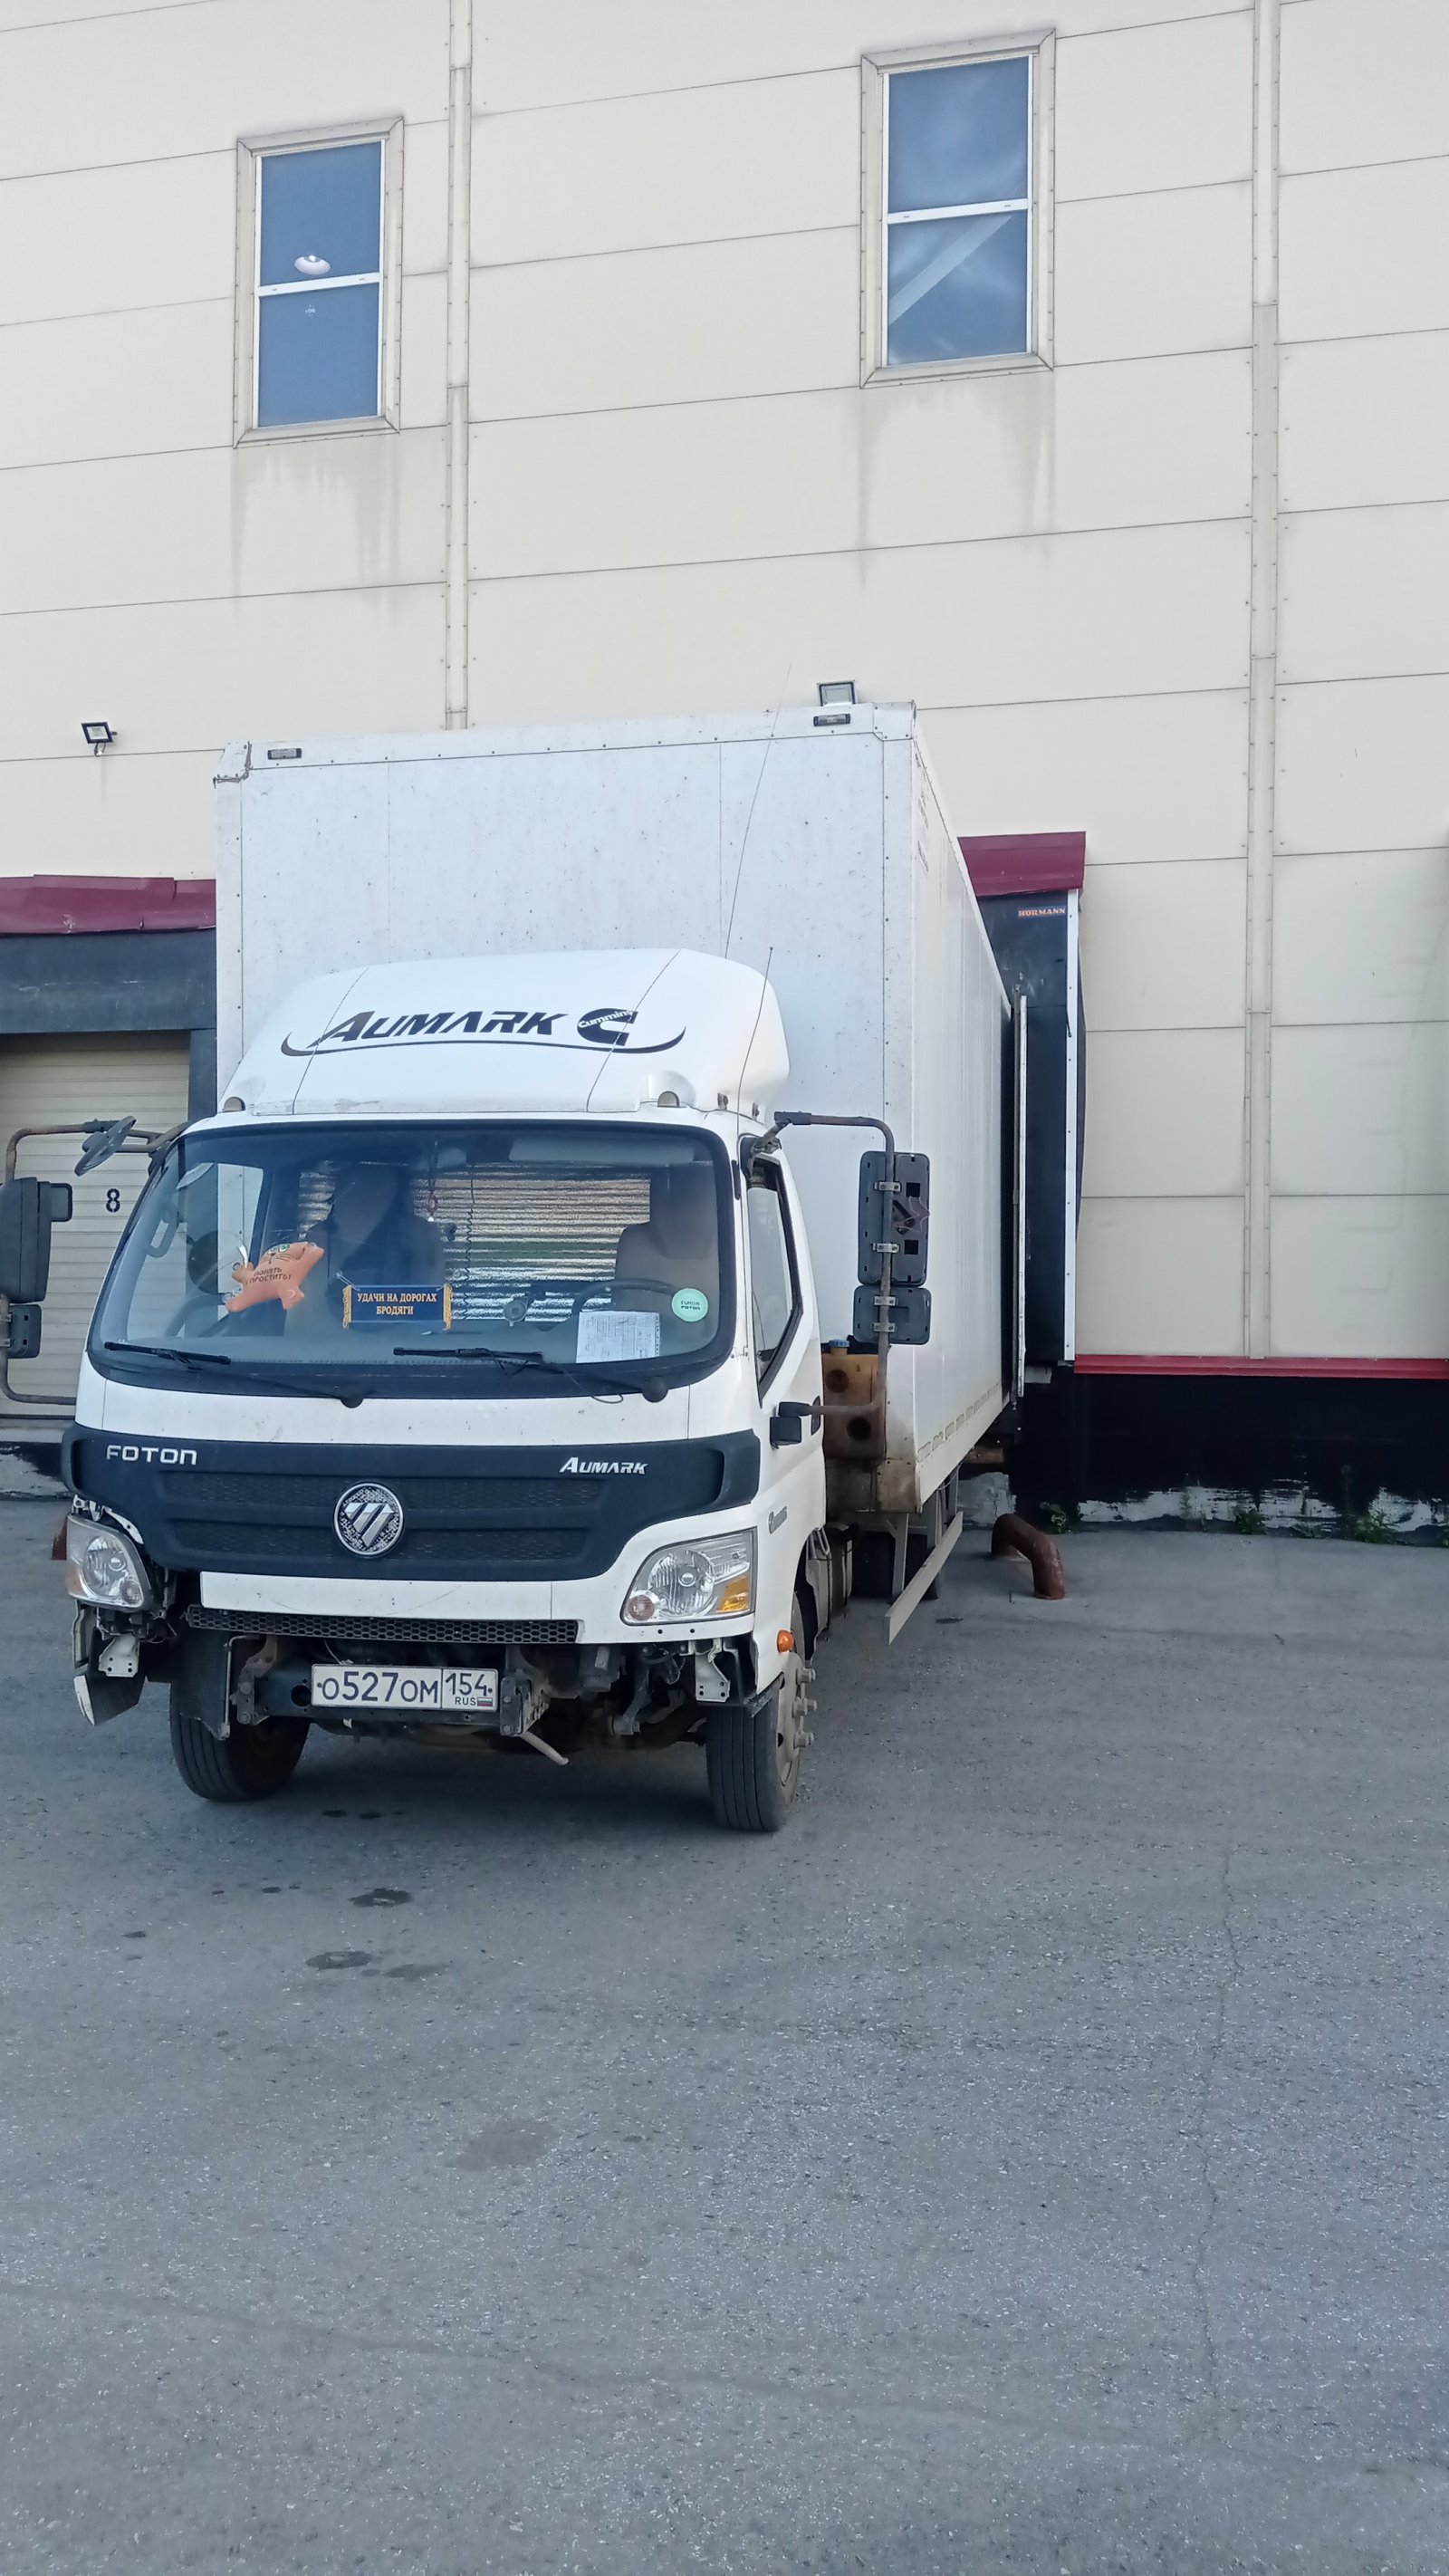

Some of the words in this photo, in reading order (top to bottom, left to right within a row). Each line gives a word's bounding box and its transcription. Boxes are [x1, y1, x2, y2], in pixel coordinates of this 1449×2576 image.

[105, 1187, 121, 1213] 8
[357, 1293, 385, 1302] УДАЧИ
[387, 1293, 398, 1302] НА
[399, 1293, 437, 1302] ДОРОГАХ
[376, 1305, 414, 1316] БРОДЯГИ
[106, 1444, 198, 1466] FOTON
[445, 1672, 489, 1697] 154
[455, 1697, 476, 1706] RUS
